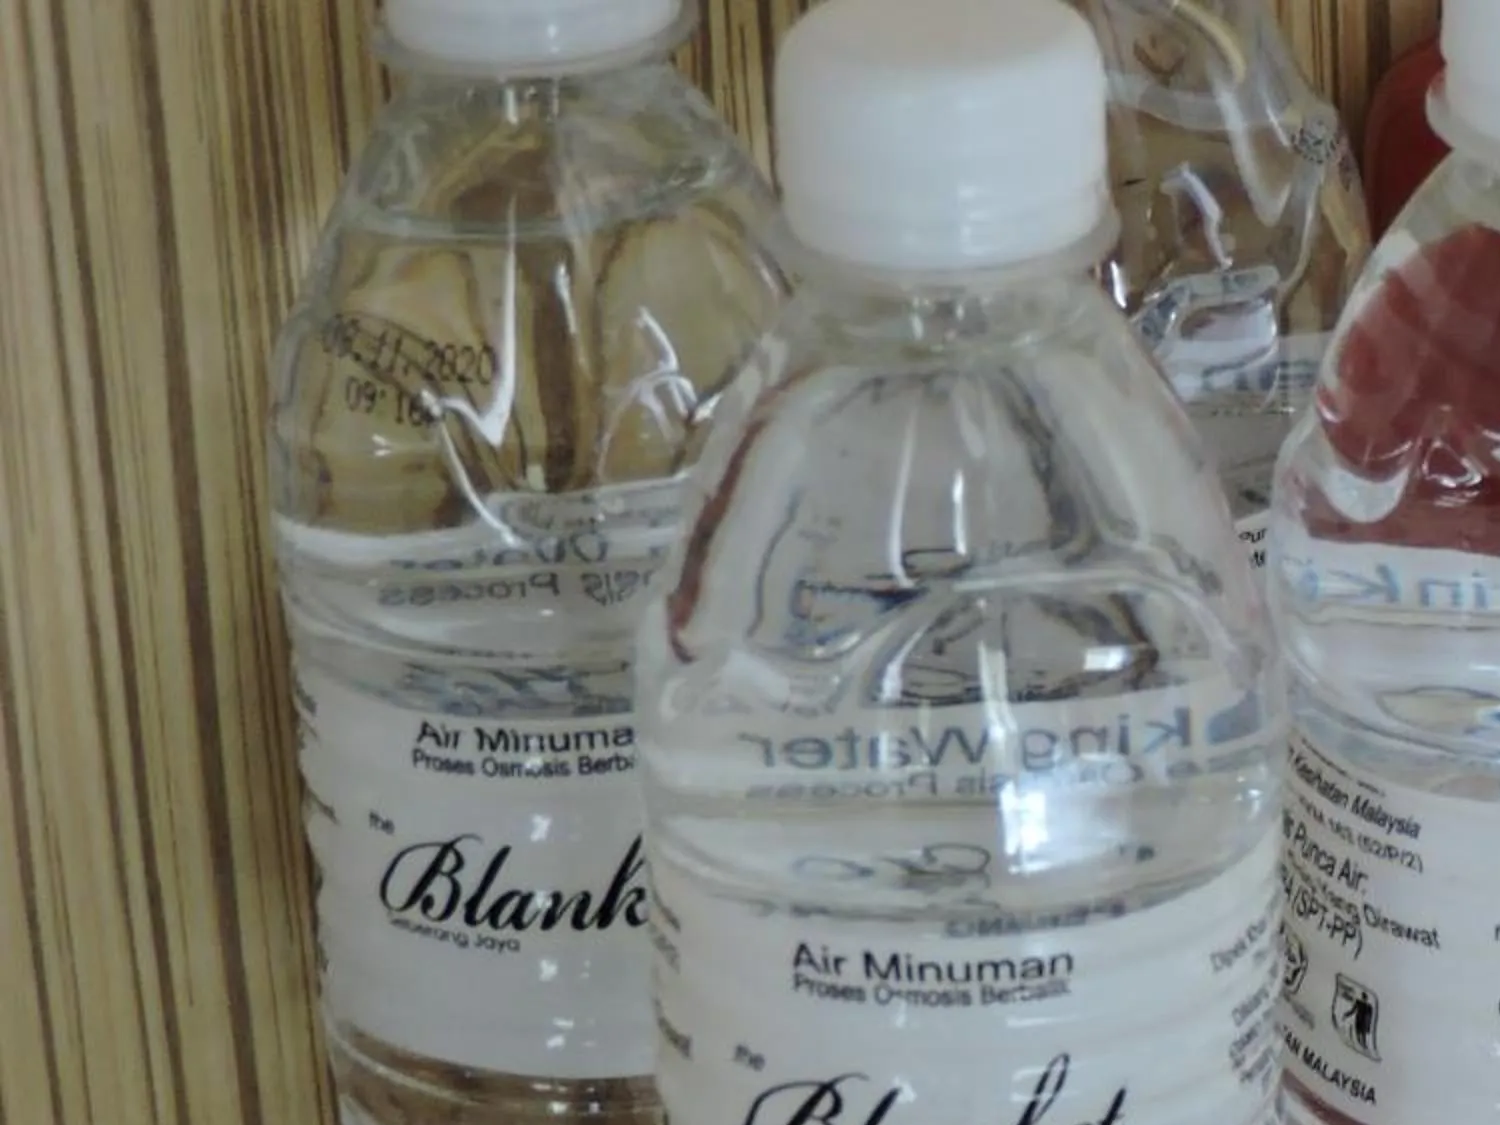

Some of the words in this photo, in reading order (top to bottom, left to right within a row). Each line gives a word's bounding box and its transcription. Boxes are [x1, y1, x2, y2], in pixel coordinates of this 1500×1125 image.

[415, 719, 462, 750] Air
[474, 726, 635, 754] Minuma
[411, 748, 476, 776] Proses
[577, 754, 636, 776] Berb
[367, 808, 396, 836] the
[1351, 794, 1422, 840] Malaysia
[1292, 822, 1337, 877] Punca
[379, 832, 649, 932] Blank
[473, 932, 521, 955] Jaya
[792, 940, 848, 977] Air
[861, 948, 1075, 983] Minuman
[792, 971, 867, 1004] Proses
[873, 982, 972, 1008] Osmosis
[732, 1041, 767, 1072] the
[1303, 1047, 1378, 1106] MALAYSIA
